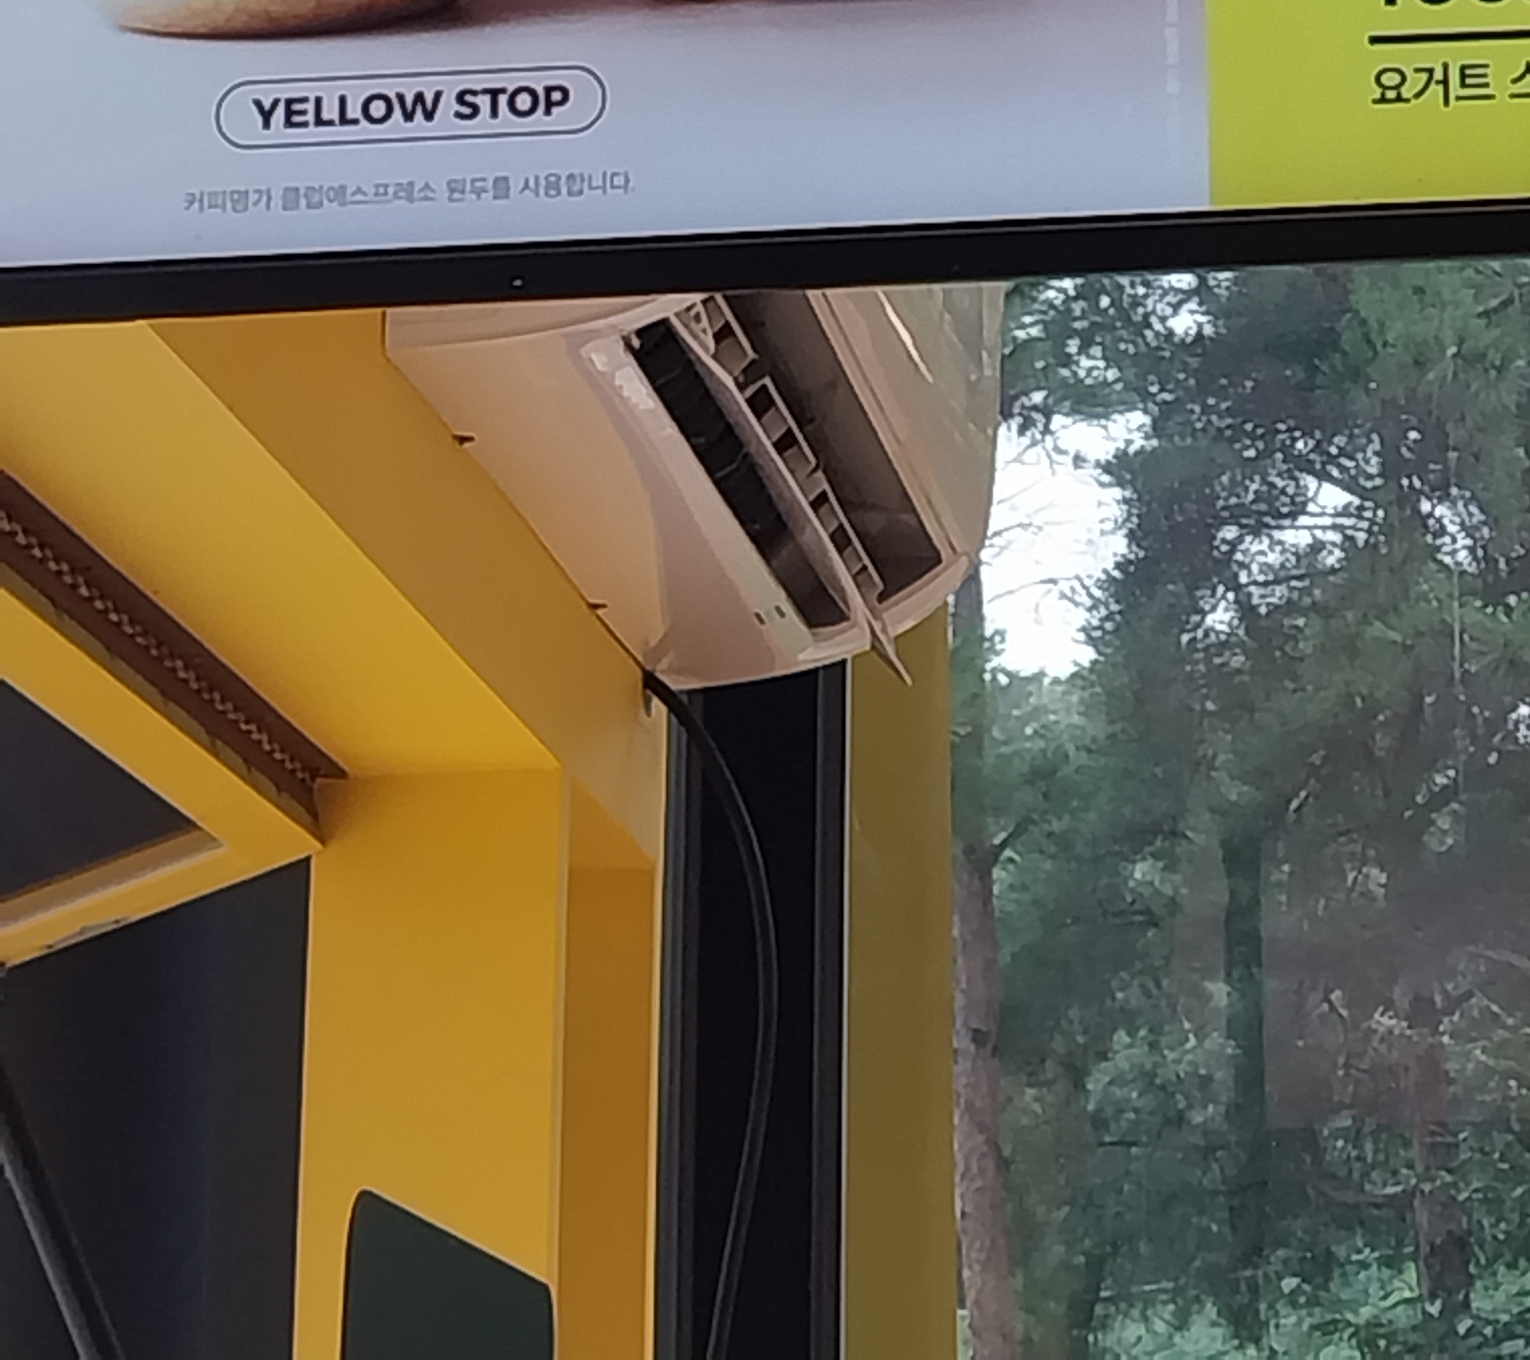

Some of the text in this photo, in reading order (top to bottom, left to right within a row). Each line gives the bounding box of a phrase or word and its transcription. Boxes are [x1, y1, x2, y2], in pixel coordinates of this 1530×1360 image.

[253, 84, 570, 130] YELLOW STOP
[1372, 62, 1495, 107] 요거트
[184, 187, 272, 213] 커피명가
[282, 181, 436, 211] 클럽에스프레소
[446, 176, 510, 202] 원두를
